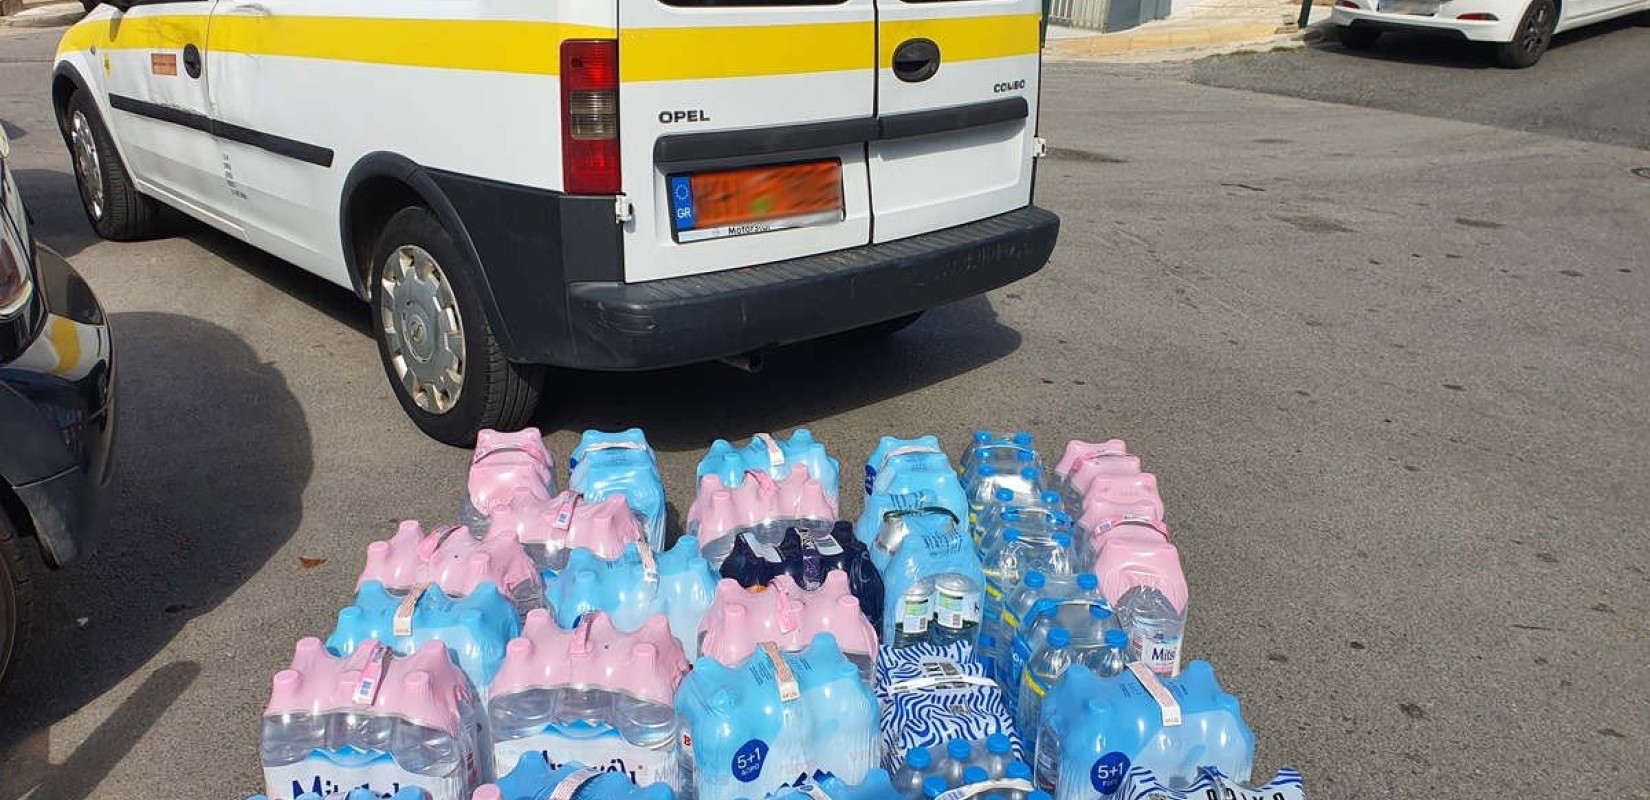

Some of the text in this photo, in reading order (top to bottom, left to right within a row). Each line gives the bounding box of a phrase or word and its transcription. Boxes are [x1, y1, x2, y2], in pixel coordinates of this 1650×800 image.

[658, 109, 711, 123] OPEL
[677, 206, 691, 218] GR
[737, 747, 761, 769] 5+1
[1097, 762, 1123, 779] 5+1
